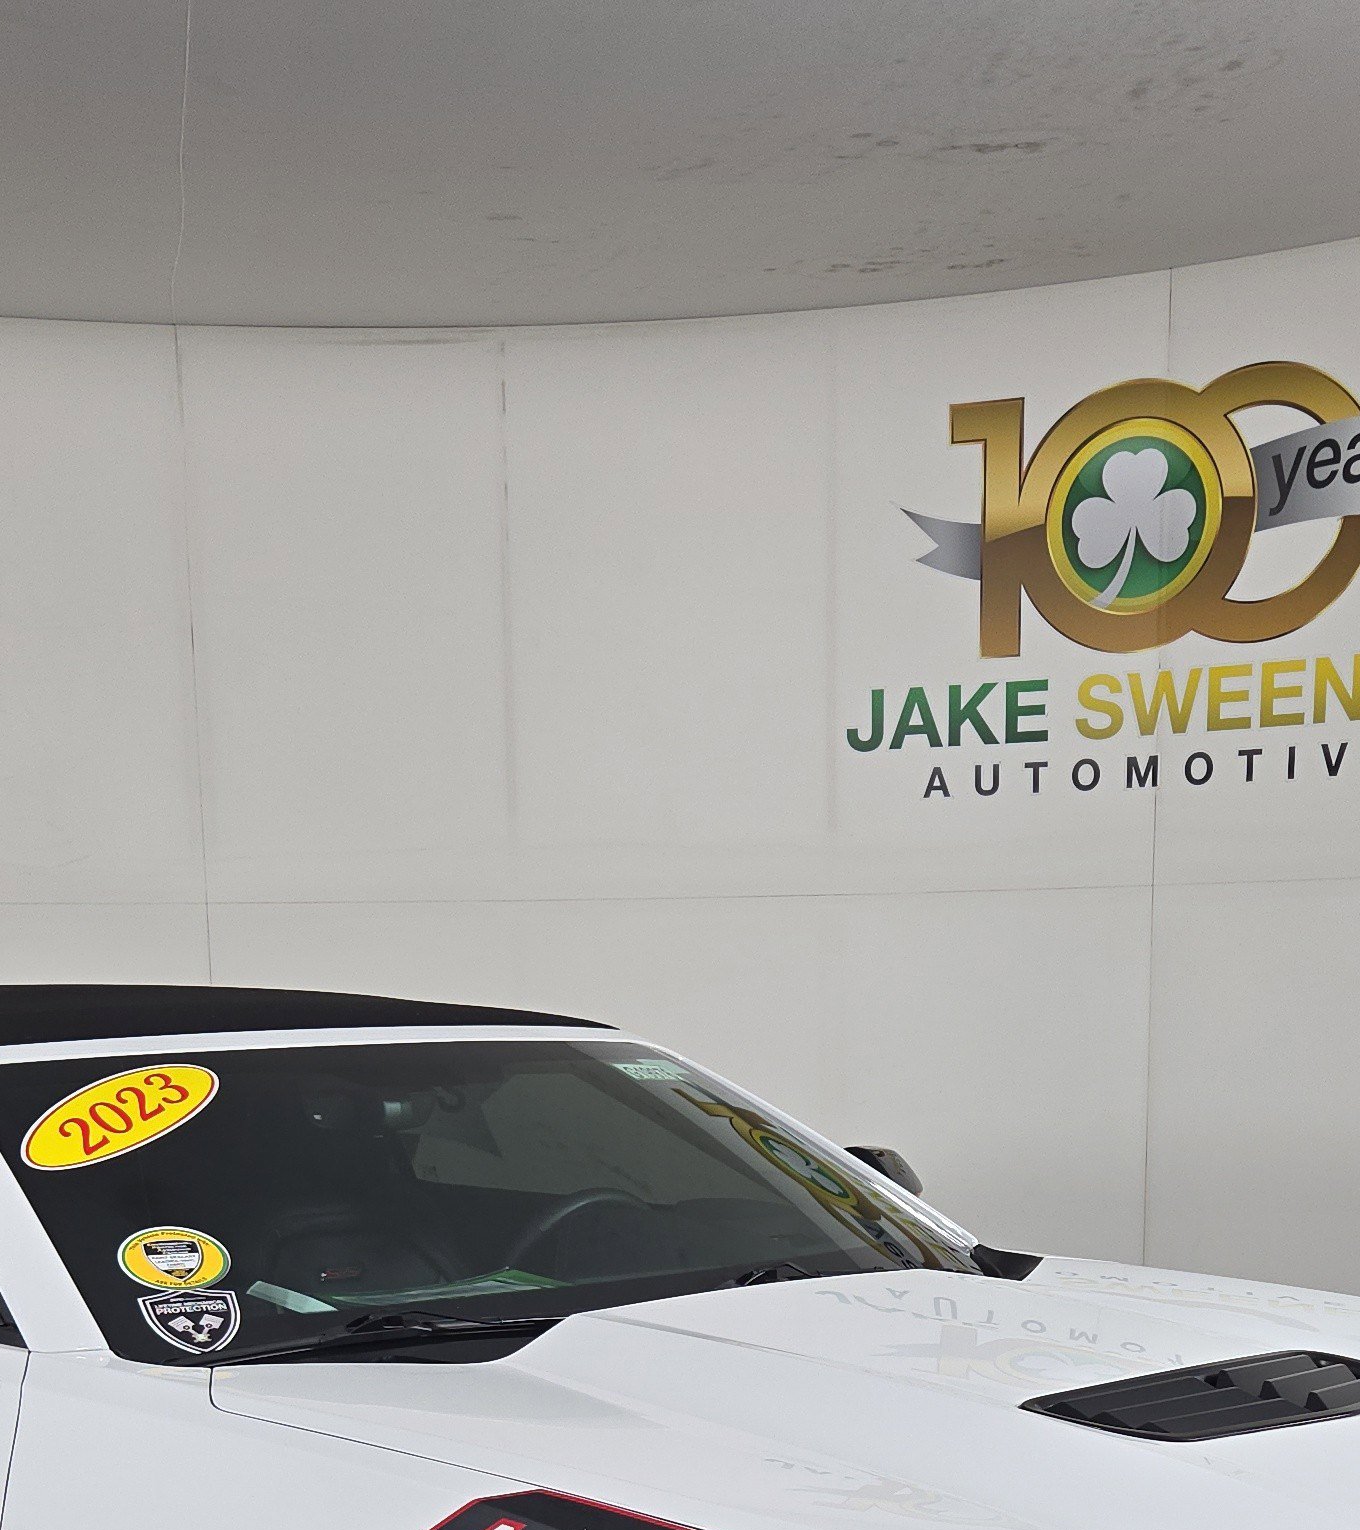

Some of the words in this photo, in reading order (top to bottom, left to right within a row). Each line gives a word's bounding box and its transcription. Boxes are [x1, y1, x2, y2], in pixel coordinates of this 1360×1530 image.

[846, 679, 1049, 753] JAKE
[58, 1072, 190, 1156] 2023
[154, 1302, 228, 1316] PROTECTION
